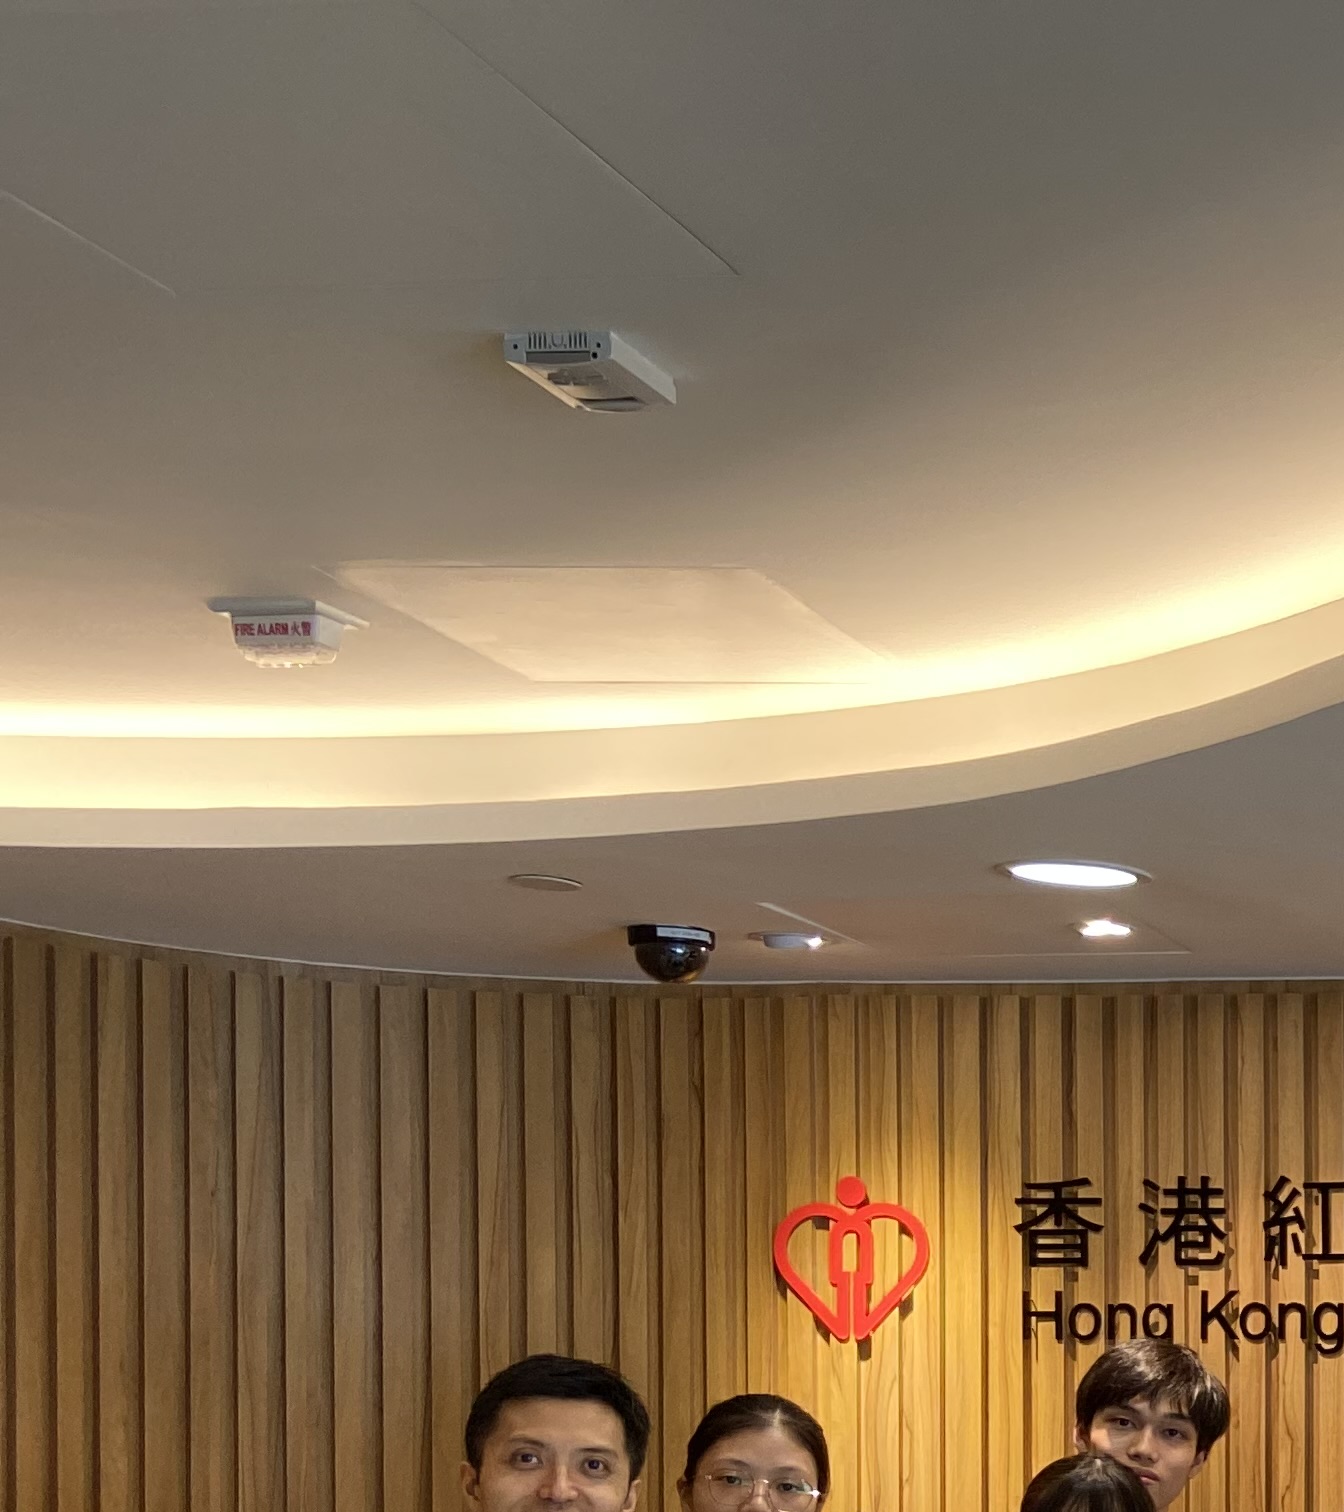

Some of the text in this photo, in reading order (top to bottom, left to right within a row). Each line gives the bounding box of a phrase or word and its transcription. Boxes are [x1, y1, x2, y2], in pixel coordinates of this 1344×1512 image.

[234, 622, 289, 636] FIRE ALARM
[1021, 1289, 1173, 1343] Hong
